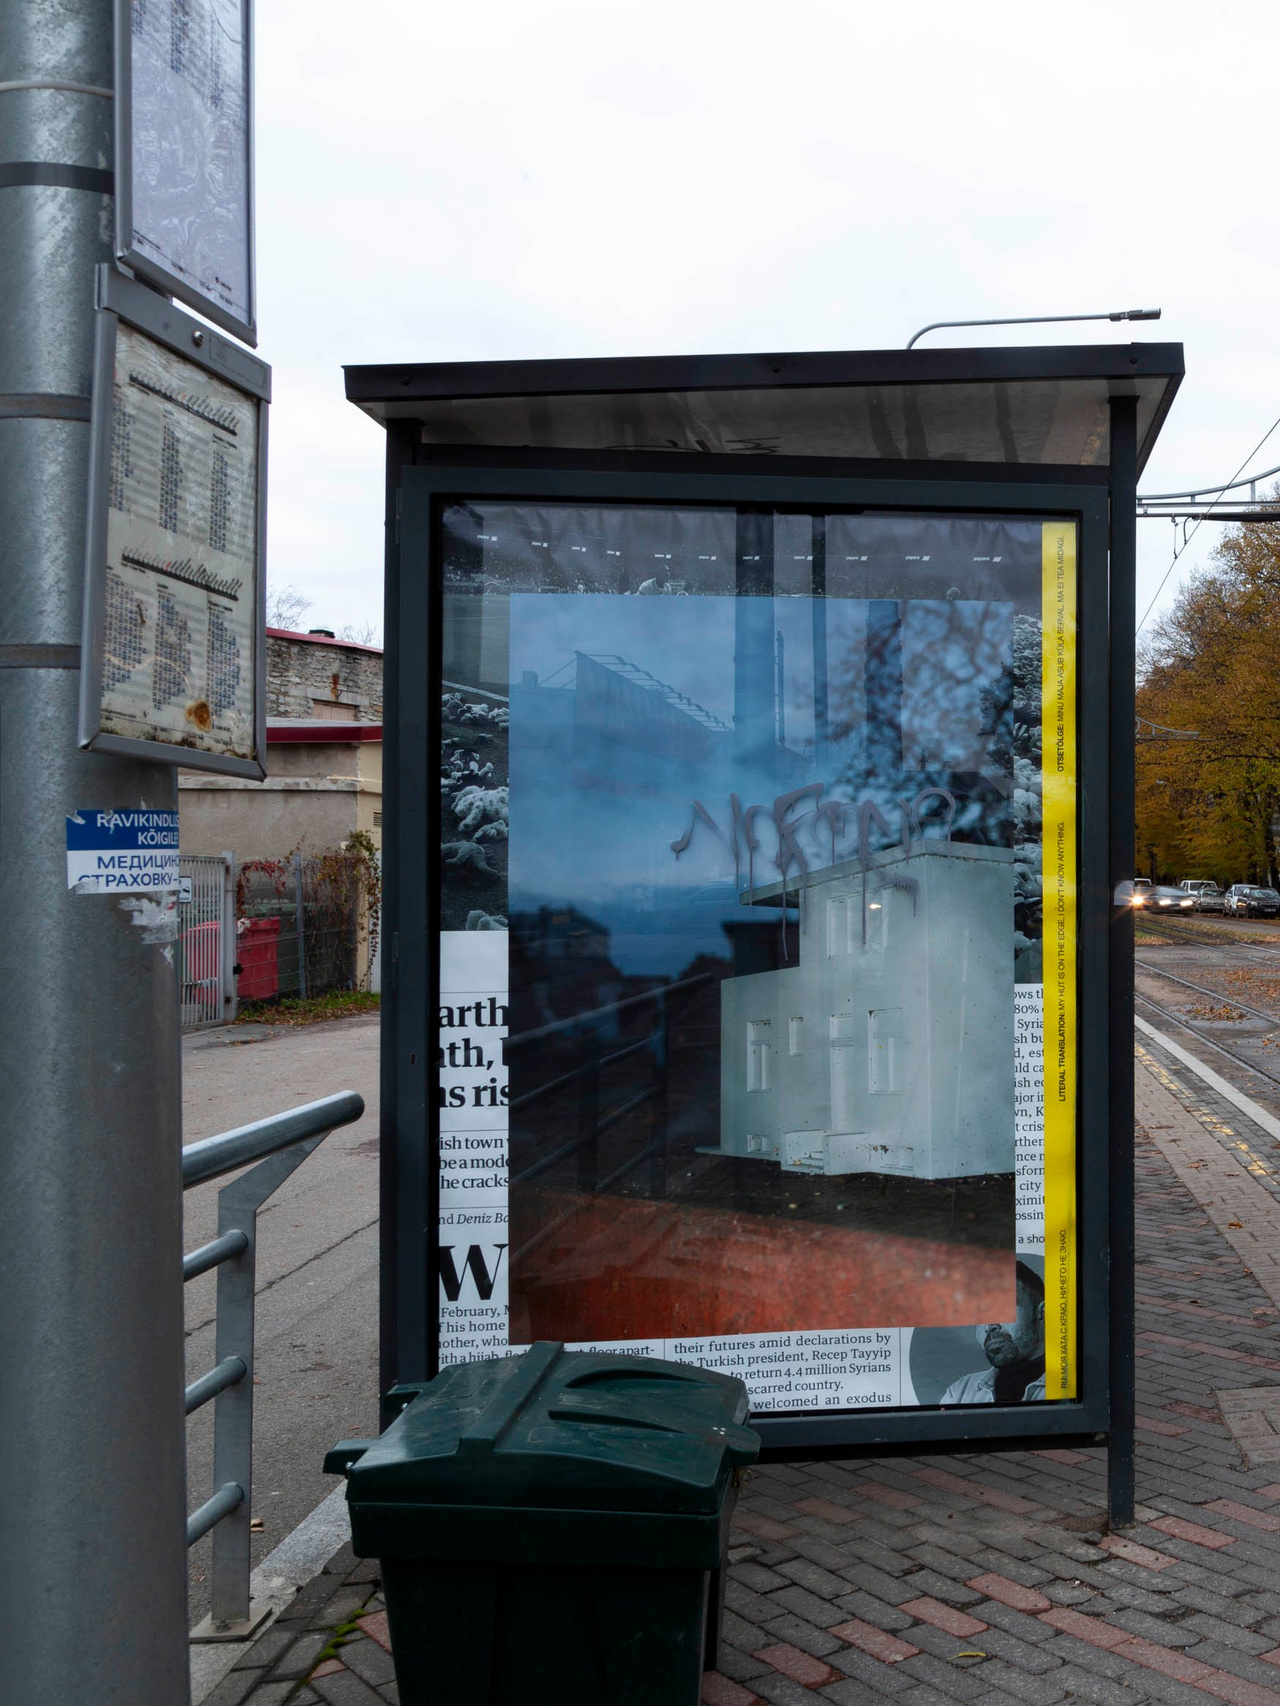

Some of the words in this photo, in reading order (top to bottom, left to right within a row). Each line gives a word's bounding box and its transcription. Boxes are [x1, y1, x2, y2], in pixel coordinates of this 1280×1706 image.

[1056, 566, 1064, 580] TEA
[1056, 580, 1064, 589] EI
[1056, 590, 1064, 602] MA
[1056, 605, 1066, 634] SERVAL,
[1055, 635, 1065, 655] KÜLA
[1056, 657, 1065, 678] ASUB
[1056, 679, 1065, 700] MAJA
[1056, 701, 1065, 721] MINU
[1055, 723, 1065, 772] OTSETÕLGE:
[1056, 821, 1065, 861] ANYTHING.
[1056, 862, 1065, 886] KNOW
[1056, 888, 1065, 912] DON'T
[1057, 918, 1066, 940] EDGE,
[1057, 941, 1065, 957] THE
[1057, 958, 1065, 970] ON
[1057, 971, 1065, 979] IS
[1057, 980, 1065, 996] HUT
[1014, 1004, 1040, 1014] 80%
[1057, 998, 1065, 1010] MY
[1058, 1010, 1066, 1068] TRANSLATION:
[1058, 1068, 1066, 1101] LITERAL
[465, 1138, 504, 1150] town
[458, 1159, 467, 1169] a
[1015, 1151, 1037, 1162] nce
[1019, 1180, 1042, 1193] city
[456, 1212, 492, 1225] Deniz
[1015, 1209, 1044, 1220] ossin
[1018, 1236, 1024, 1244] a
[1058, 1228, 1067, 1253] ЗНАЮ.
[1059, 1254, 1067, 1265] НЕ
[439, 1244, 509, 1301] W
[1059, 1267, 1067, 1299] НИЧЕГО
[441, 1305, 501, 1319] February,
[447, 1321, 465, 1333] his
[469, 1320, 506, 1332] home
[439, 1337, 479, 1349] other,
[481, 1335, 509, 1347] who
[674, 1342, 704, 1354] their
[708, 1340, 756, 1352] futures
[759, 1336, 791, 1349] amid
[796, 1334, 872, 1347] declarations
[876, 1332, 892, 1345] by
[1059, 1335, 1067, 1355] ХАТА
[439, 1353, 458, 1364] ith
[697, 1354, 745, 1368] Turkish
[747, 1350, 809, 1367] president,
[812, 1350, 848, 1364] Recep
[850, 1347, 892, 1361] Tayyip
[1059, 1356, 1068, 1375] МОЯ
[730, 1370, 742, 1380] to
[745, 1368, 782, 1380] return
[784, 1367, 803, 1378] 4.4
[805, 1362, 847, 1376] million
[849, 1362, 892, 1375] Syrians
[747, 1381, 792, 1394] scarred
[795, 1379, 844, 1392] country.
[753, 1395, 818, 1410] welcomed
[825, 1396, 840, 1406] an
[846, 1392, 892, 1405] exodus
